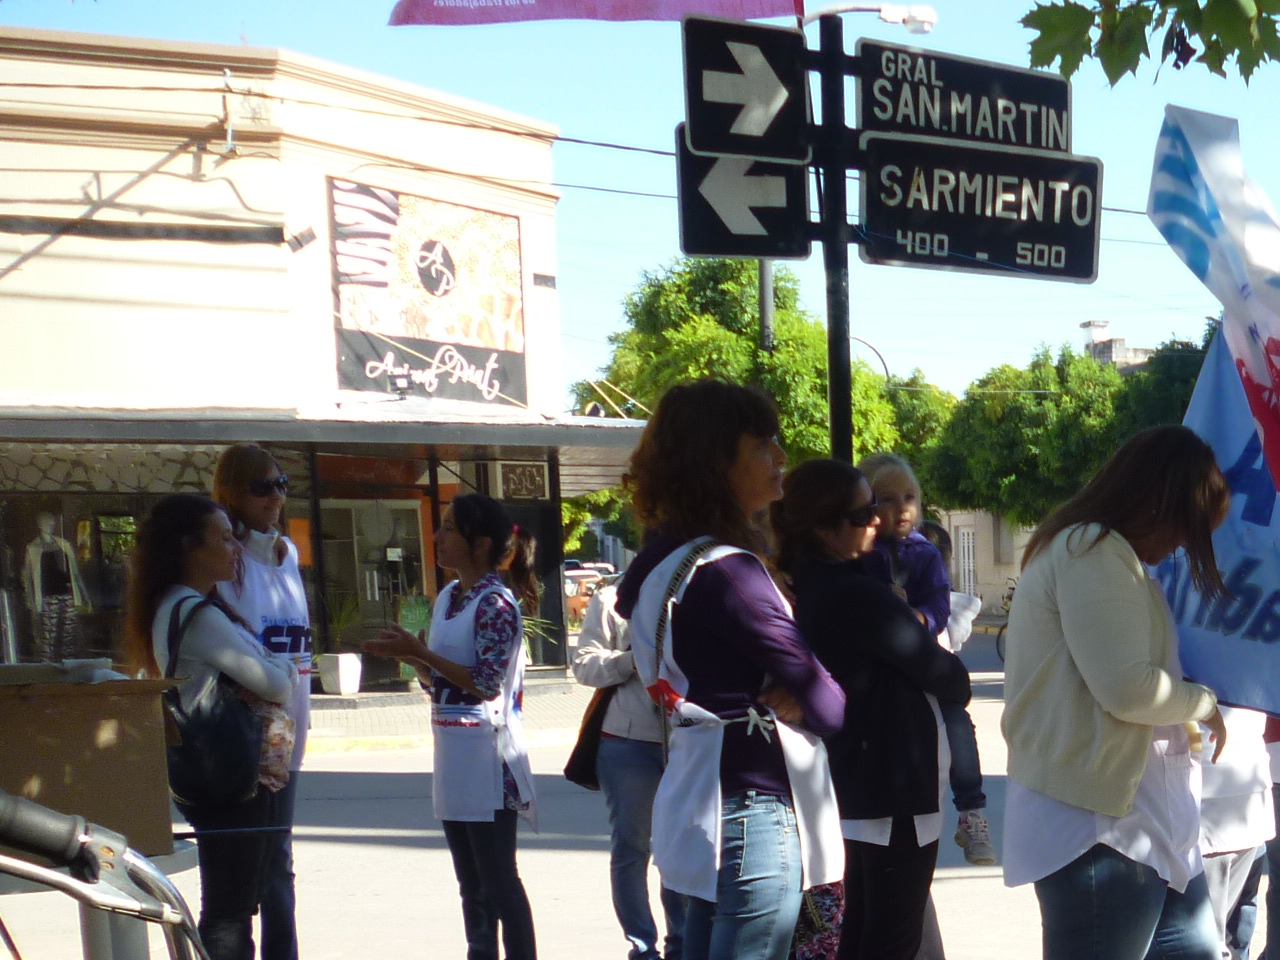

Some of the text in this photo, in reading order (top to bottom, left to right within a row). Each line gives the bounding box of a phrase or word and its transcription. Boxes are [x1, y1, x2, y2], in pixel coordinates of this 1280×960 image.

[881, 51, 944, 88] GRAL
[880, 165, 1093, 227] SARMIENTO
[896, 229, 950, 258] 400
[1015, 242, 1066, 268] 500
